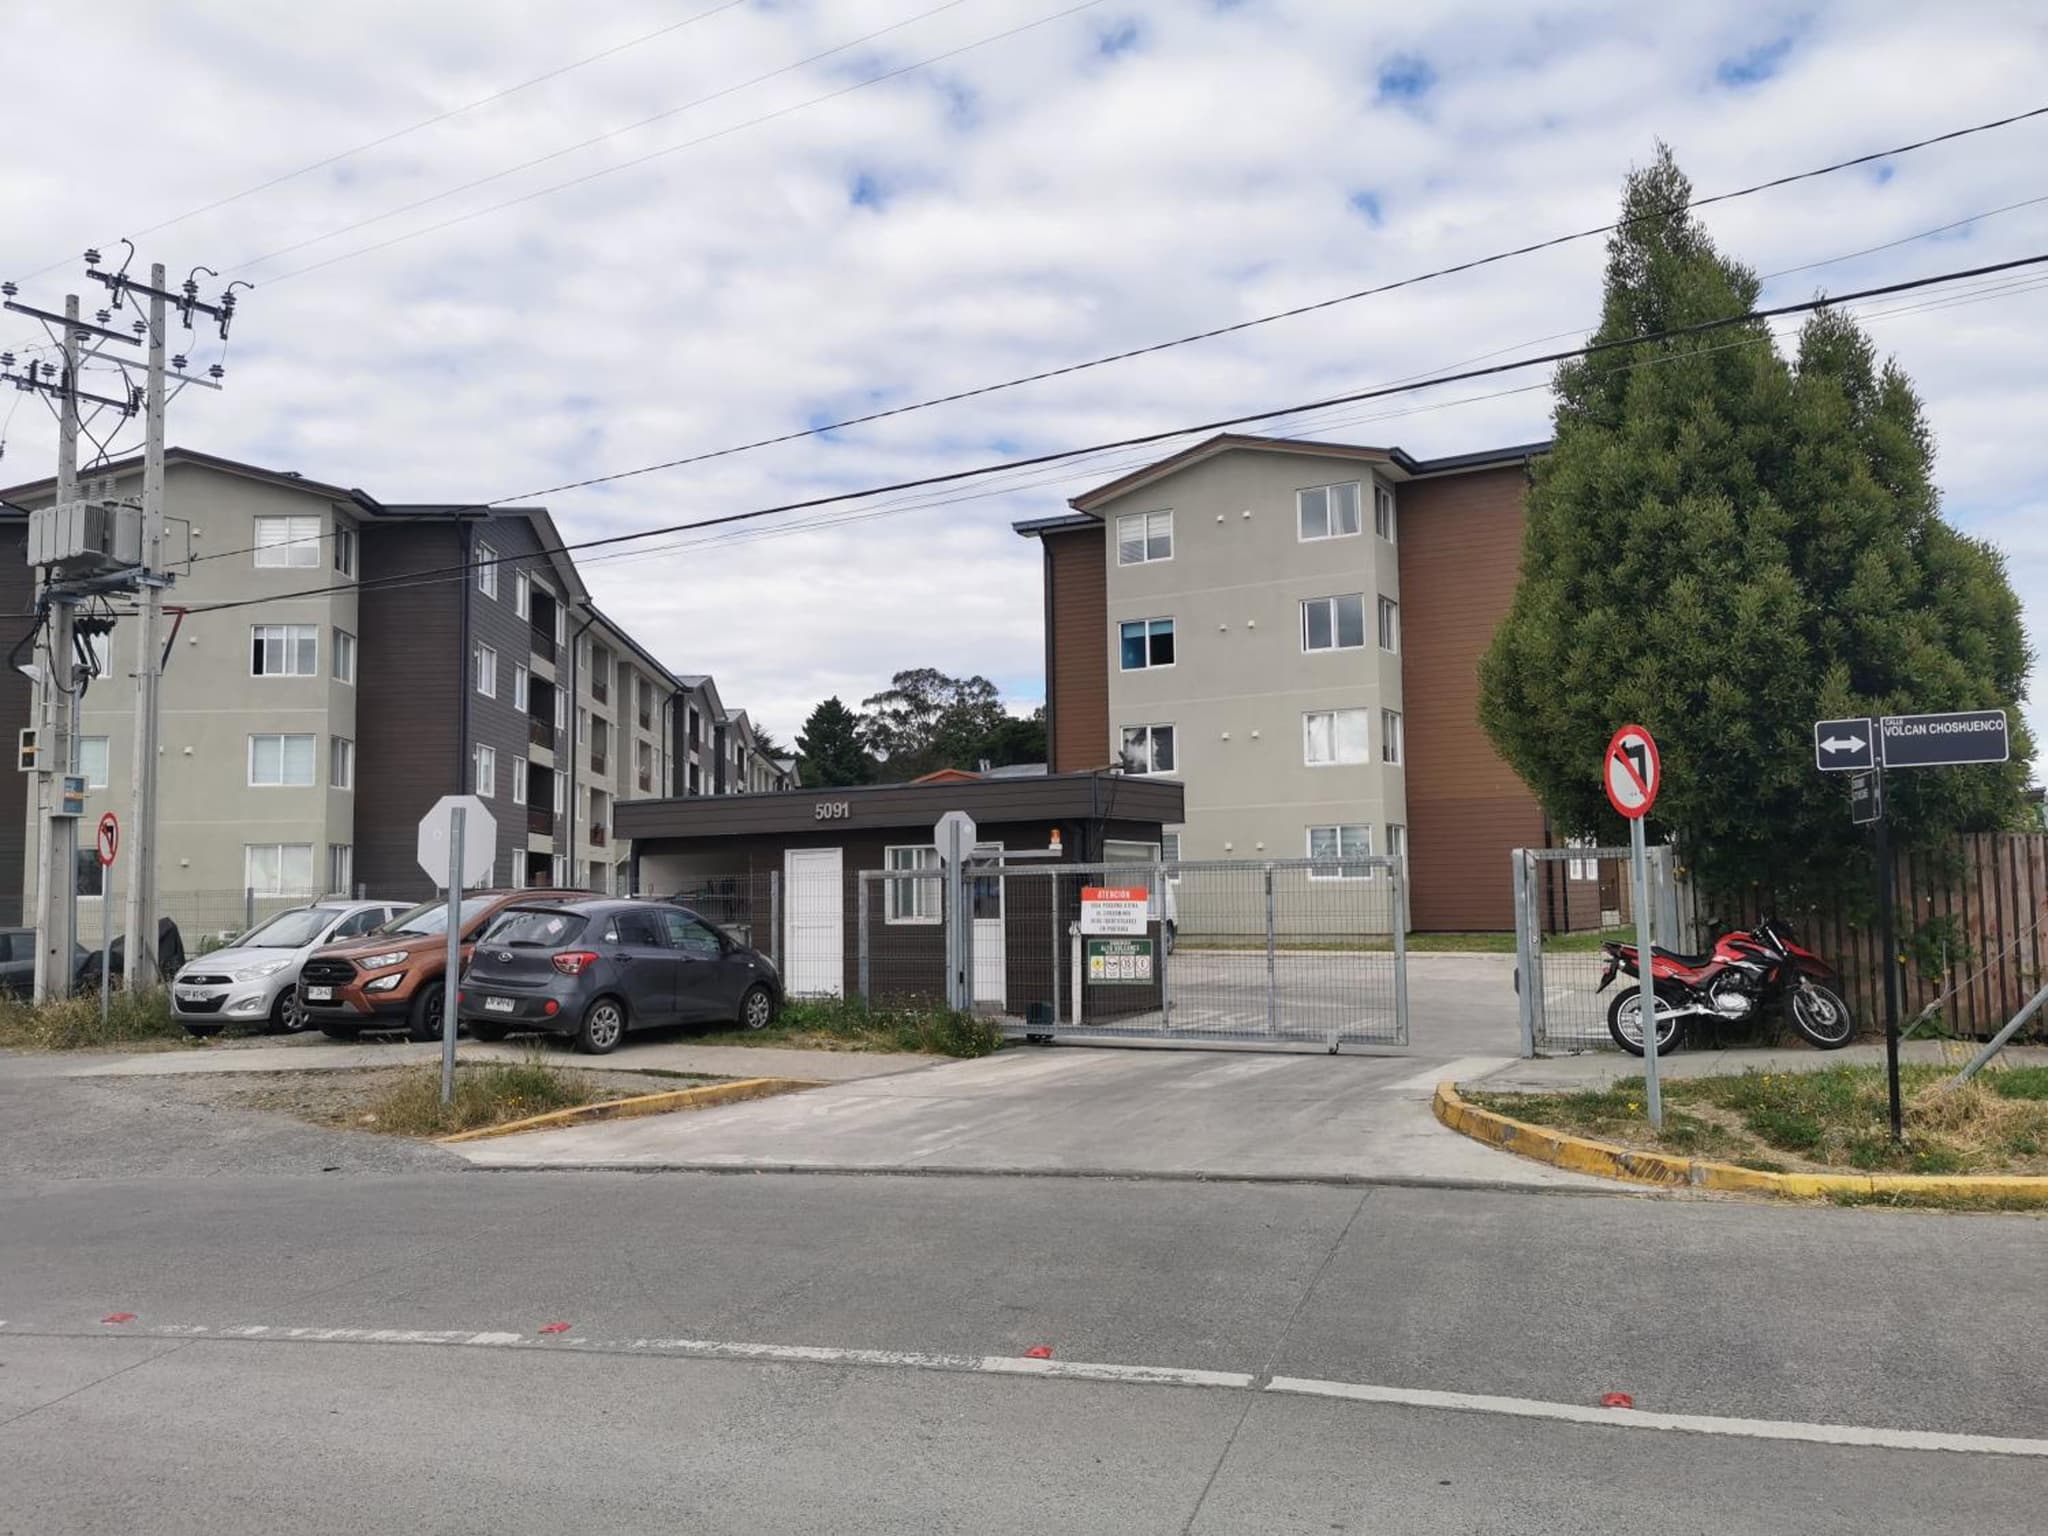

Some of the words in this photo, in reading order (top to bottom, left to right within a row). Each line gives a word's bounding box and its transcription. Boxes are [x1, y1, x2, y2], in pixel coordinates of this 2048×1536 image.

[1884, 724, 1926, 736] VOLCAN
[1928, 720, 2004, 734] CHOSHUENCO
[815, 801, 849, 820] 5091
